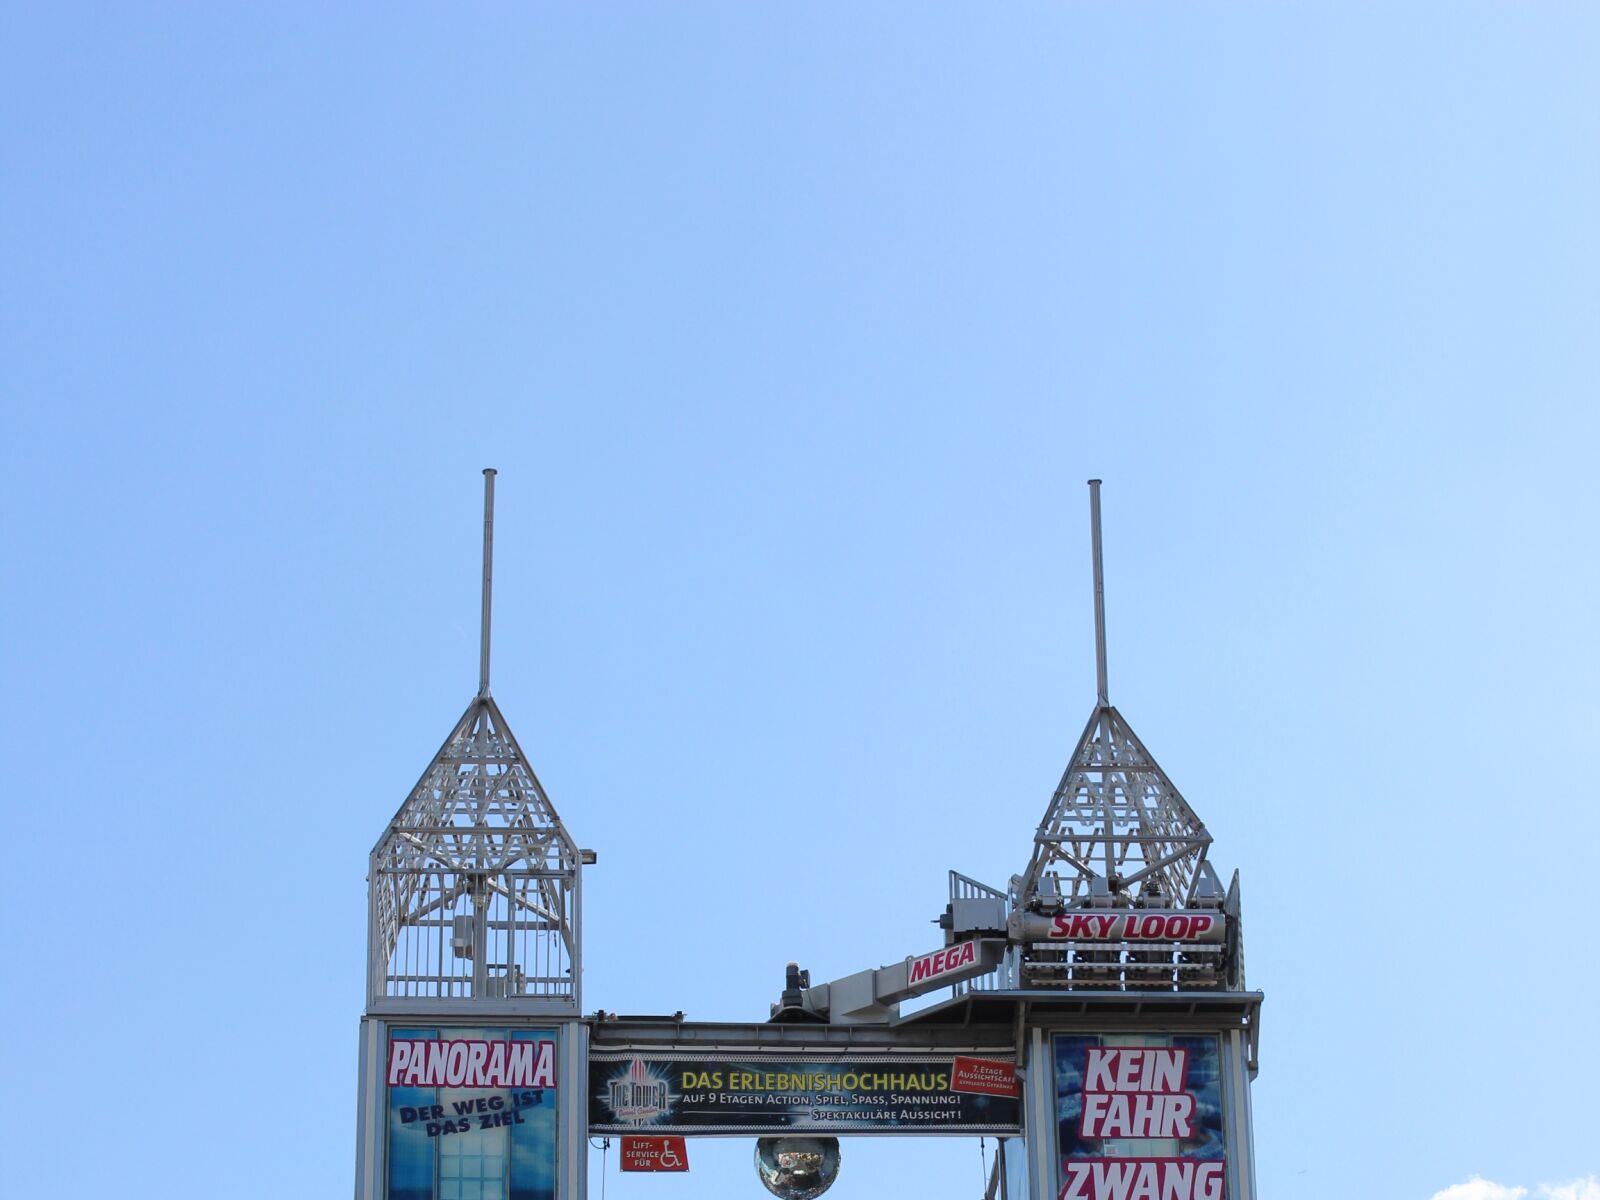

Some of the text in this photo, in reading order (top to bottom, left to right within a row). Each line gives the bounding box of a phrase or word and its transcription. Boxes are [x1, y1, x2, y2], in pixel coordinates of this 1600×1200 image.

[1048, 914, 1214, 940] SKY LOOP
[909, 941, 976, 983] MEGA
[388, 1040, 556, 1087] PANORAMA
[1084, 1047, 1187, 1093] KEIN
[682, 1071, 948, 1091] DAS ERLEBNISHOCHHAUS
[400, 1089, 544, 1124] DER WEG IST
[683, 1094, 706, 1103] AUF
[708, 1092, 717, 1103] 9
[720, 1092, 763, 1104] ETAGEN
[815, 1093, 849, 1106] SPIEL,
[851, 1093, 889, 1106] SPASS,
[890, 1093, 961, 1105] SPANNUNG!
[426, 1110, 526, 1138] DAS ZIEL
[811, 1108, 897, 1120] SPEKTAKULÄRE
[1081, 1094, 1194, 1138] FAHR
[626, 1150, 659, 1158] SERVICE
[632, 1140, 653, 1149] LIFT-
[634, 1157, 651, 1167] FÜR
